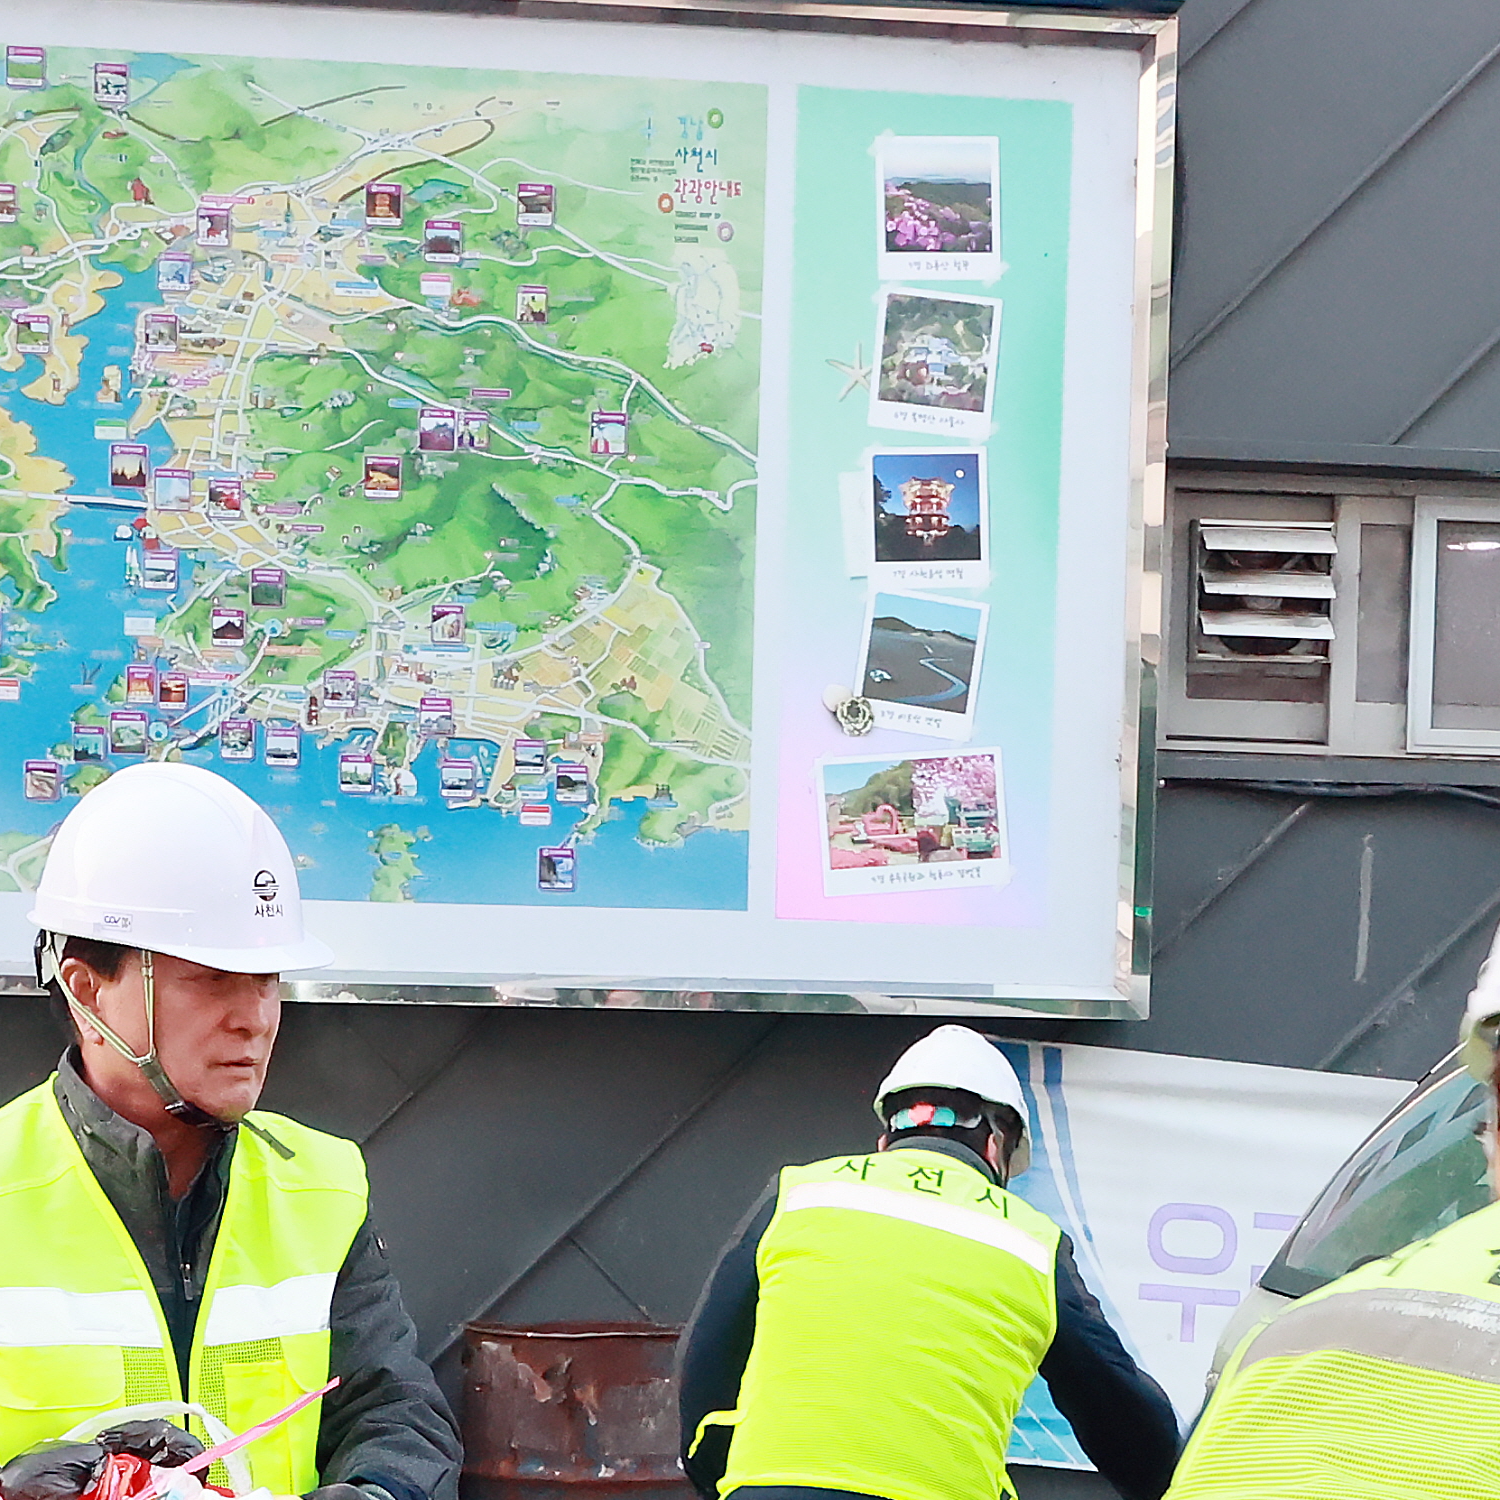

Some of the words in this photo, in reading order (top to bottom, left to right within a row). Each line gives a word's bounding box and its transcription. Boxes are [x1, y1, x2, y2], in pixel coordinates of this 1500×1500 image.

[675, 147, 717, 172] 사천시
[674, 179, 742, 205] 관광안내도
[254, 904, 284, 917] 사천시
[1138, 1201, 1300, 1344] 유
